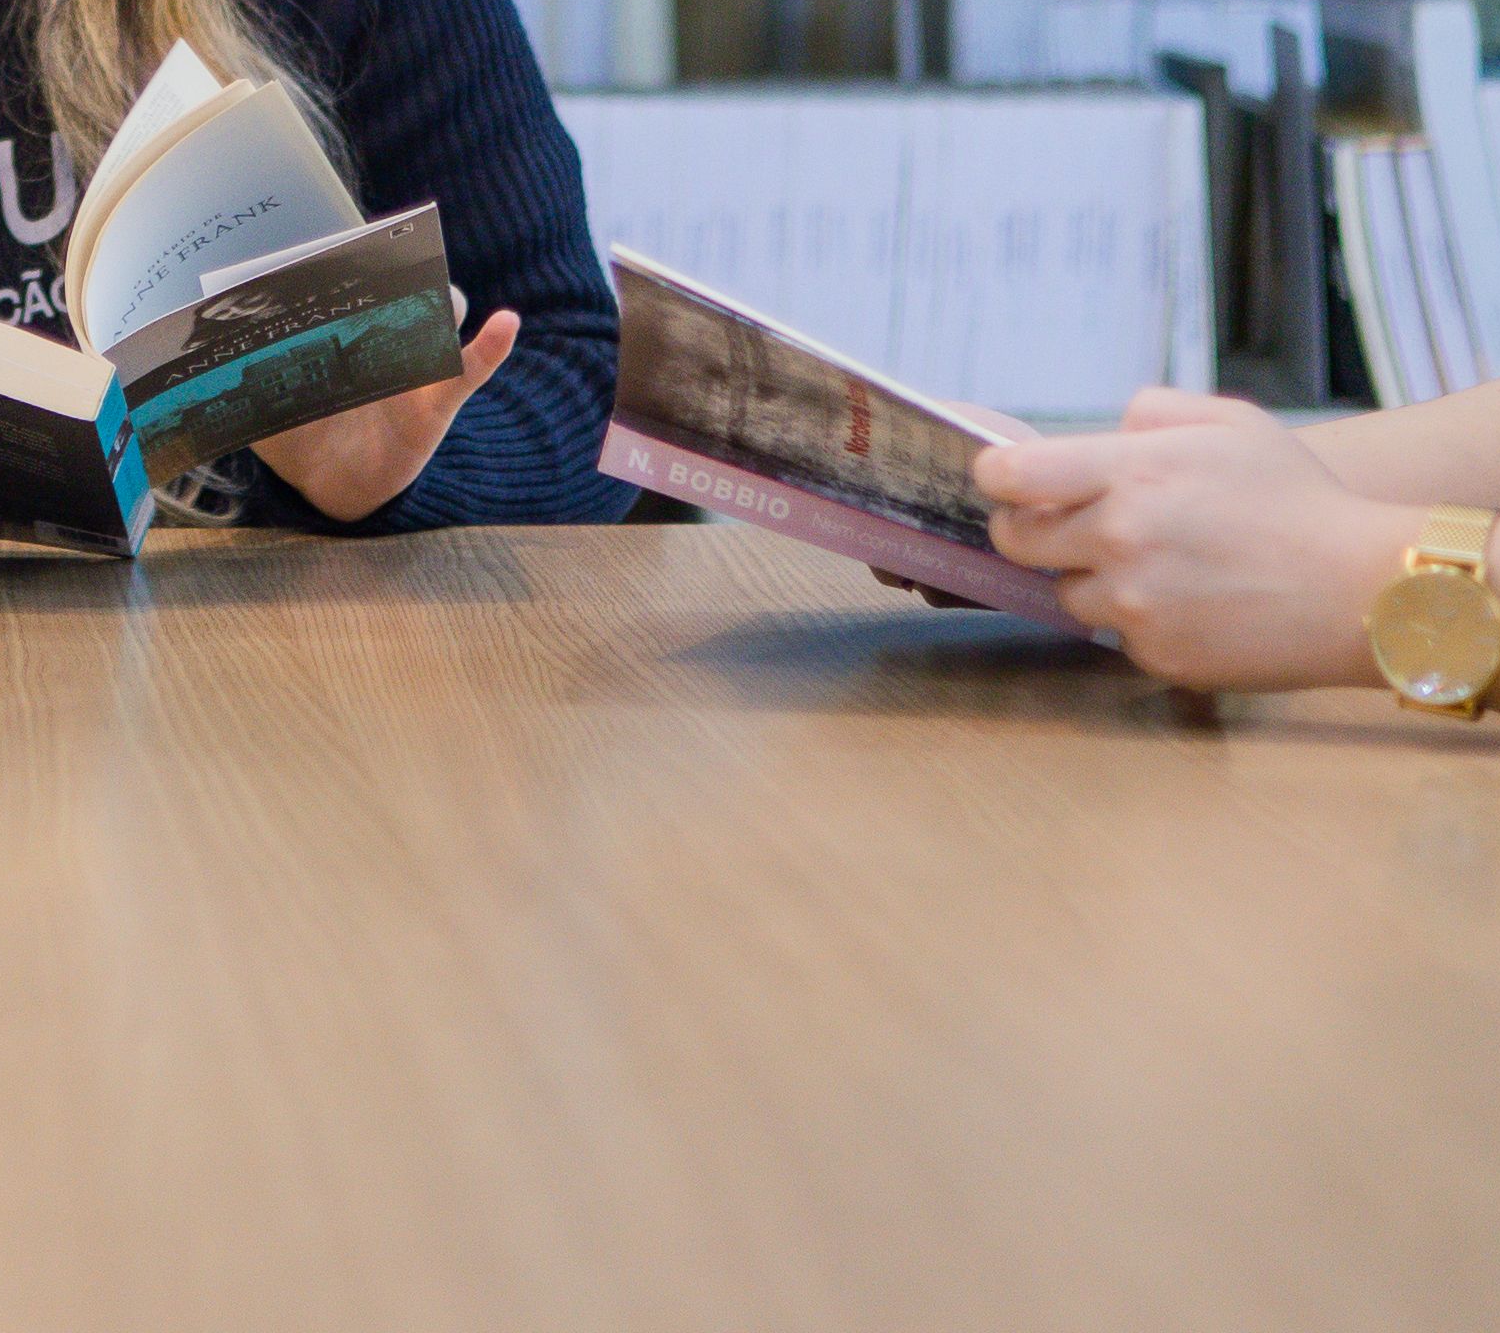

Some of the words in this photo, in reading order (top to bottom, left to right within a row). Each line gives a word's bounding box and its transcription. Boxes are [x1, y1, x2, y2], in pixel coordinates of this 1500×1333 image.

[175, 195, 282, 264] FRANK
[203, 212, 222, 227] DE
[268, 294, 377, 340] FRANK
[627, 446, 655, 476] N.
[668, 462, 792, 520] BOBBIO
[808, 510, 856, 542] Nem
[857, 528, 899, 557] com
